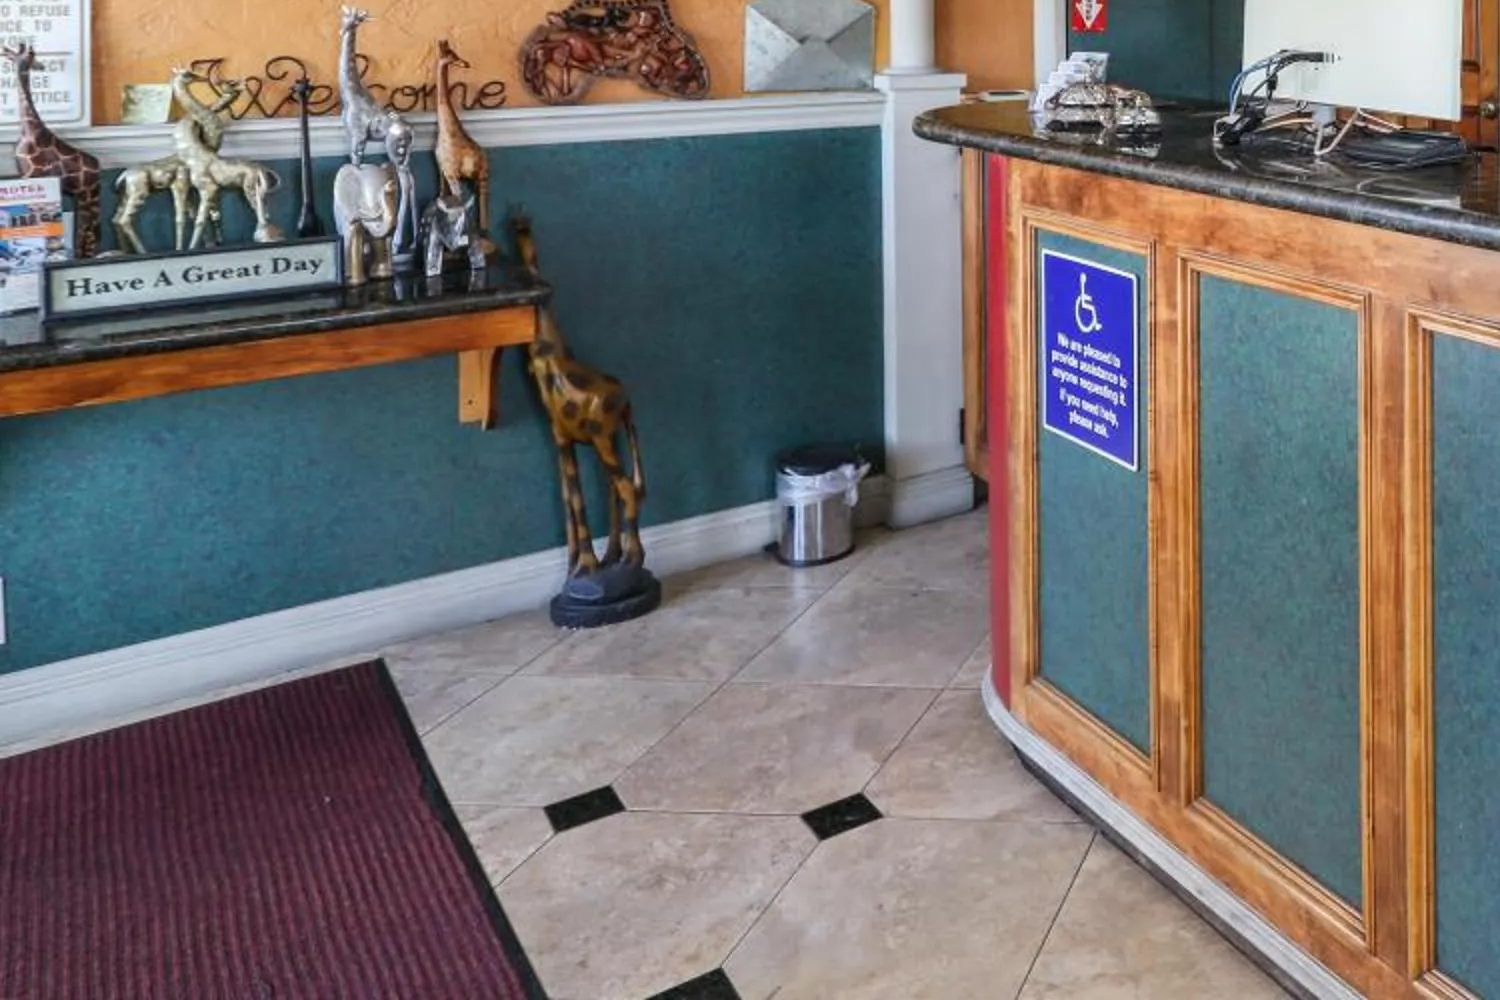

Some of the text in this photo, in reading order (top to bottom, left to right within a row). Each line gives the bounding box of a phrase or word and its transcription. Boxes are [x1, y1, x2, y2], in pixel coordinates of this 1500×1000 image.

[19, 4, 71, 18] REFUSE
[34, 19, 53, 33] TO
[65, 256, 324, 298] Have A Great Day
[1051, 349, 1079, 369] provide
[1051, 367, 1079, 385] anyone
[1067, 393, 1081, 409] you
